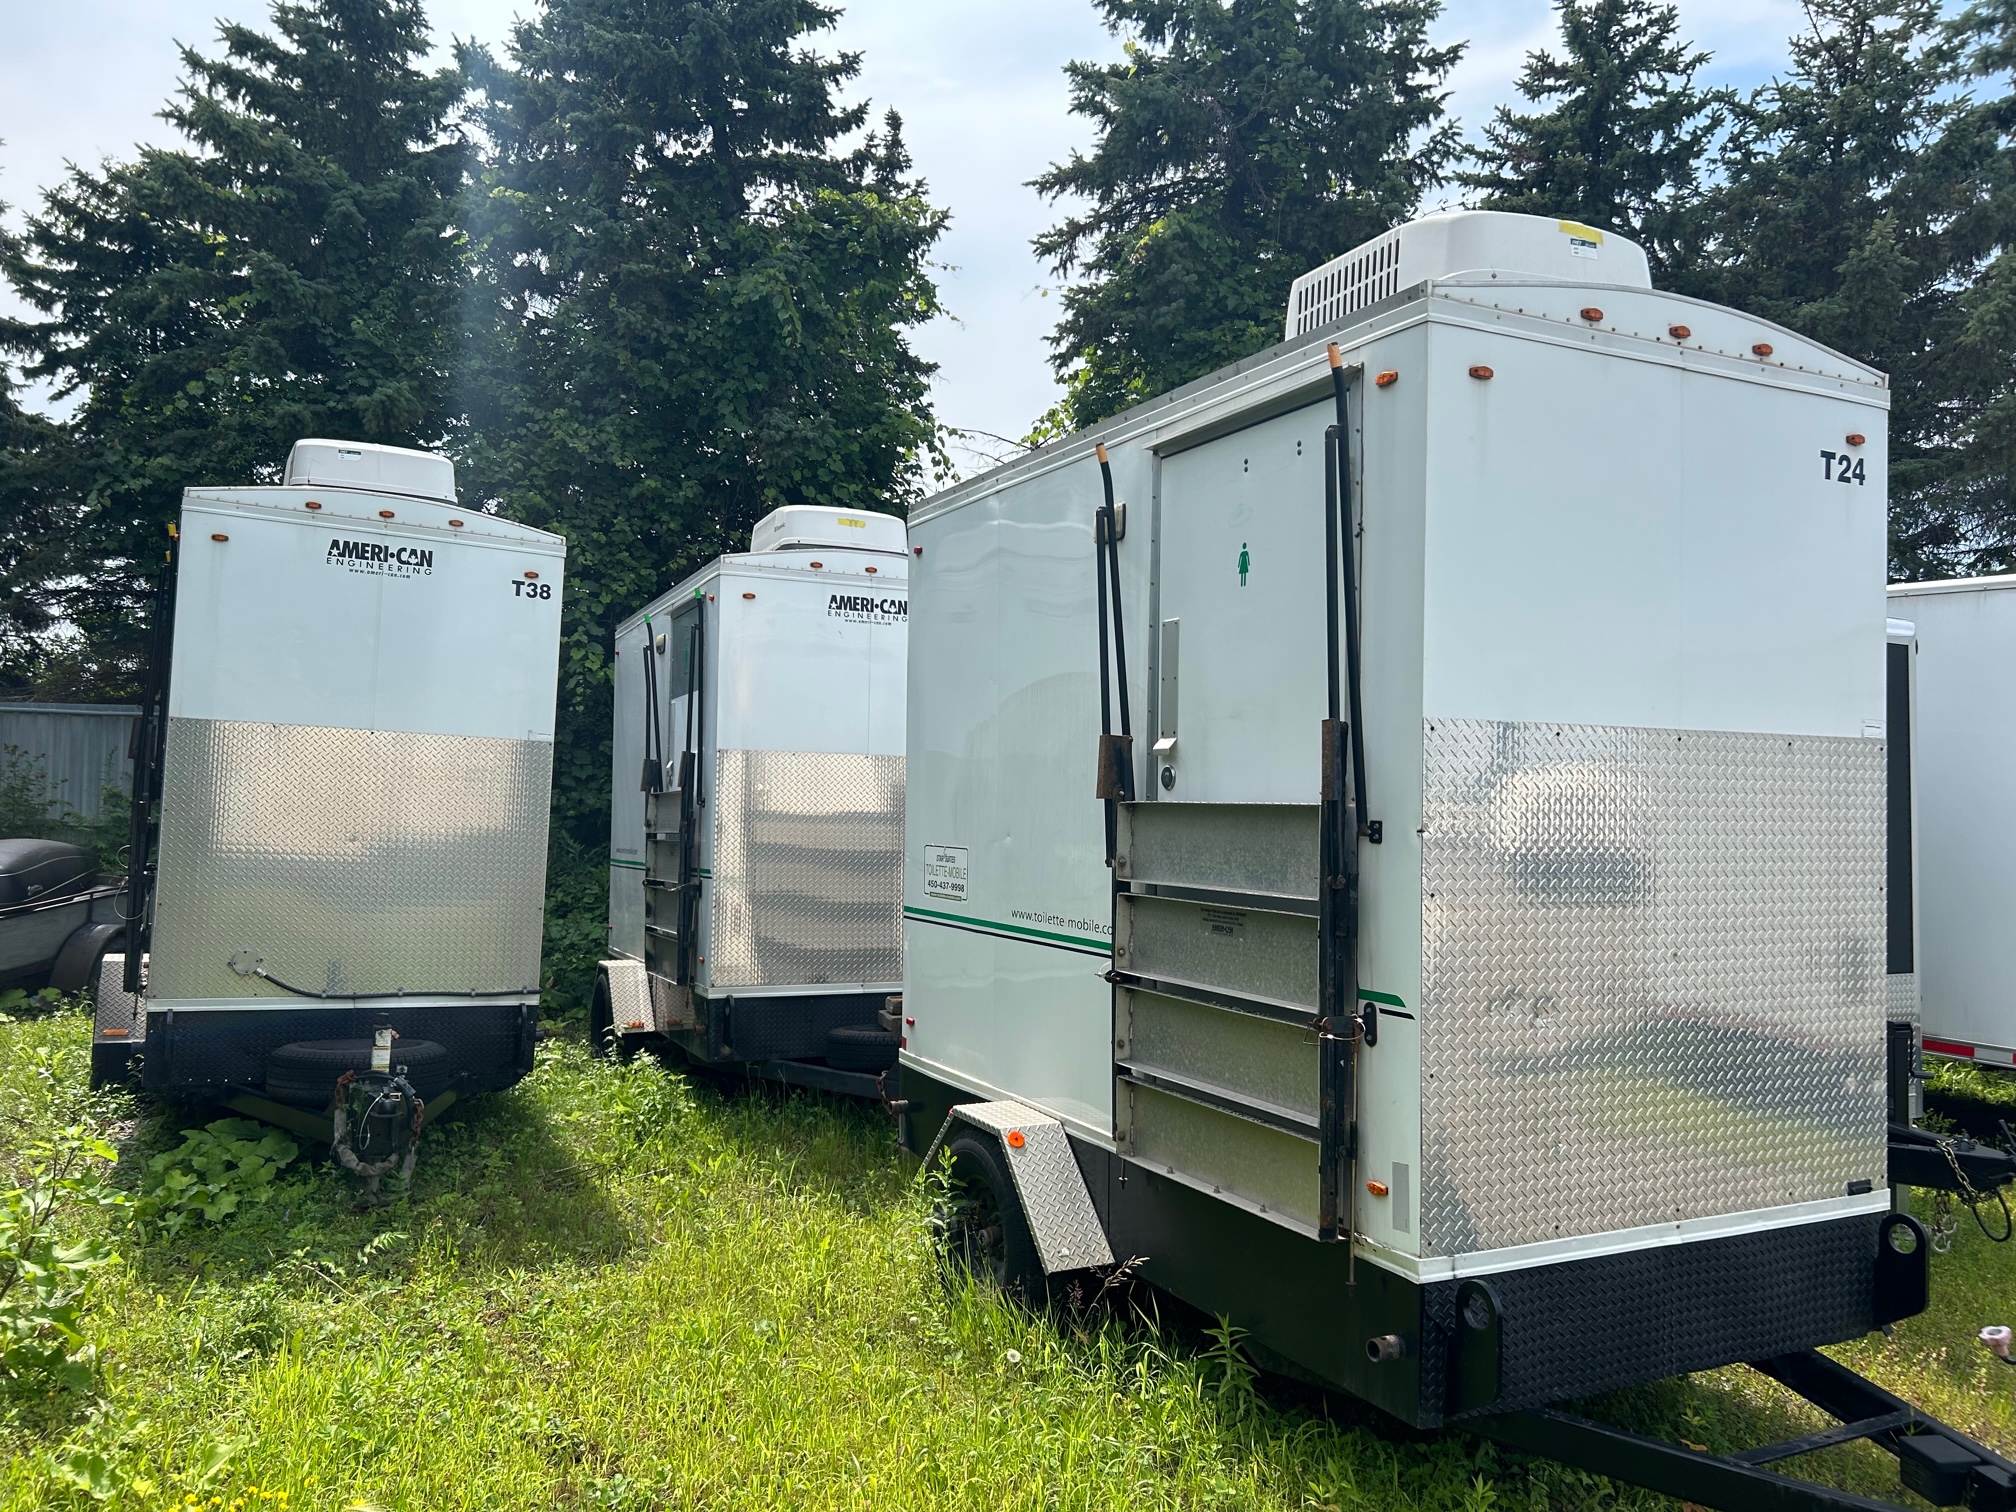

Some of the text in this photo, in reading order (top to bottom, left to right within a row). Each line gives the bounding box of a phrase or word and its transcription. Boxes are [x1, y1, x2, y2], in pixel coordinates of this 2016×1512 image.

[1820, 449, 1866, 486] T24
[326, 557, 433, 576] ENGINEERING
[511, 579, 552, 600] T38
[827, 610, 908, 623] ENGINEERING
[926, 863, 967, 880] TOILETTE-MOBILE
[927, 879, 965, 893] 450-437-9998
